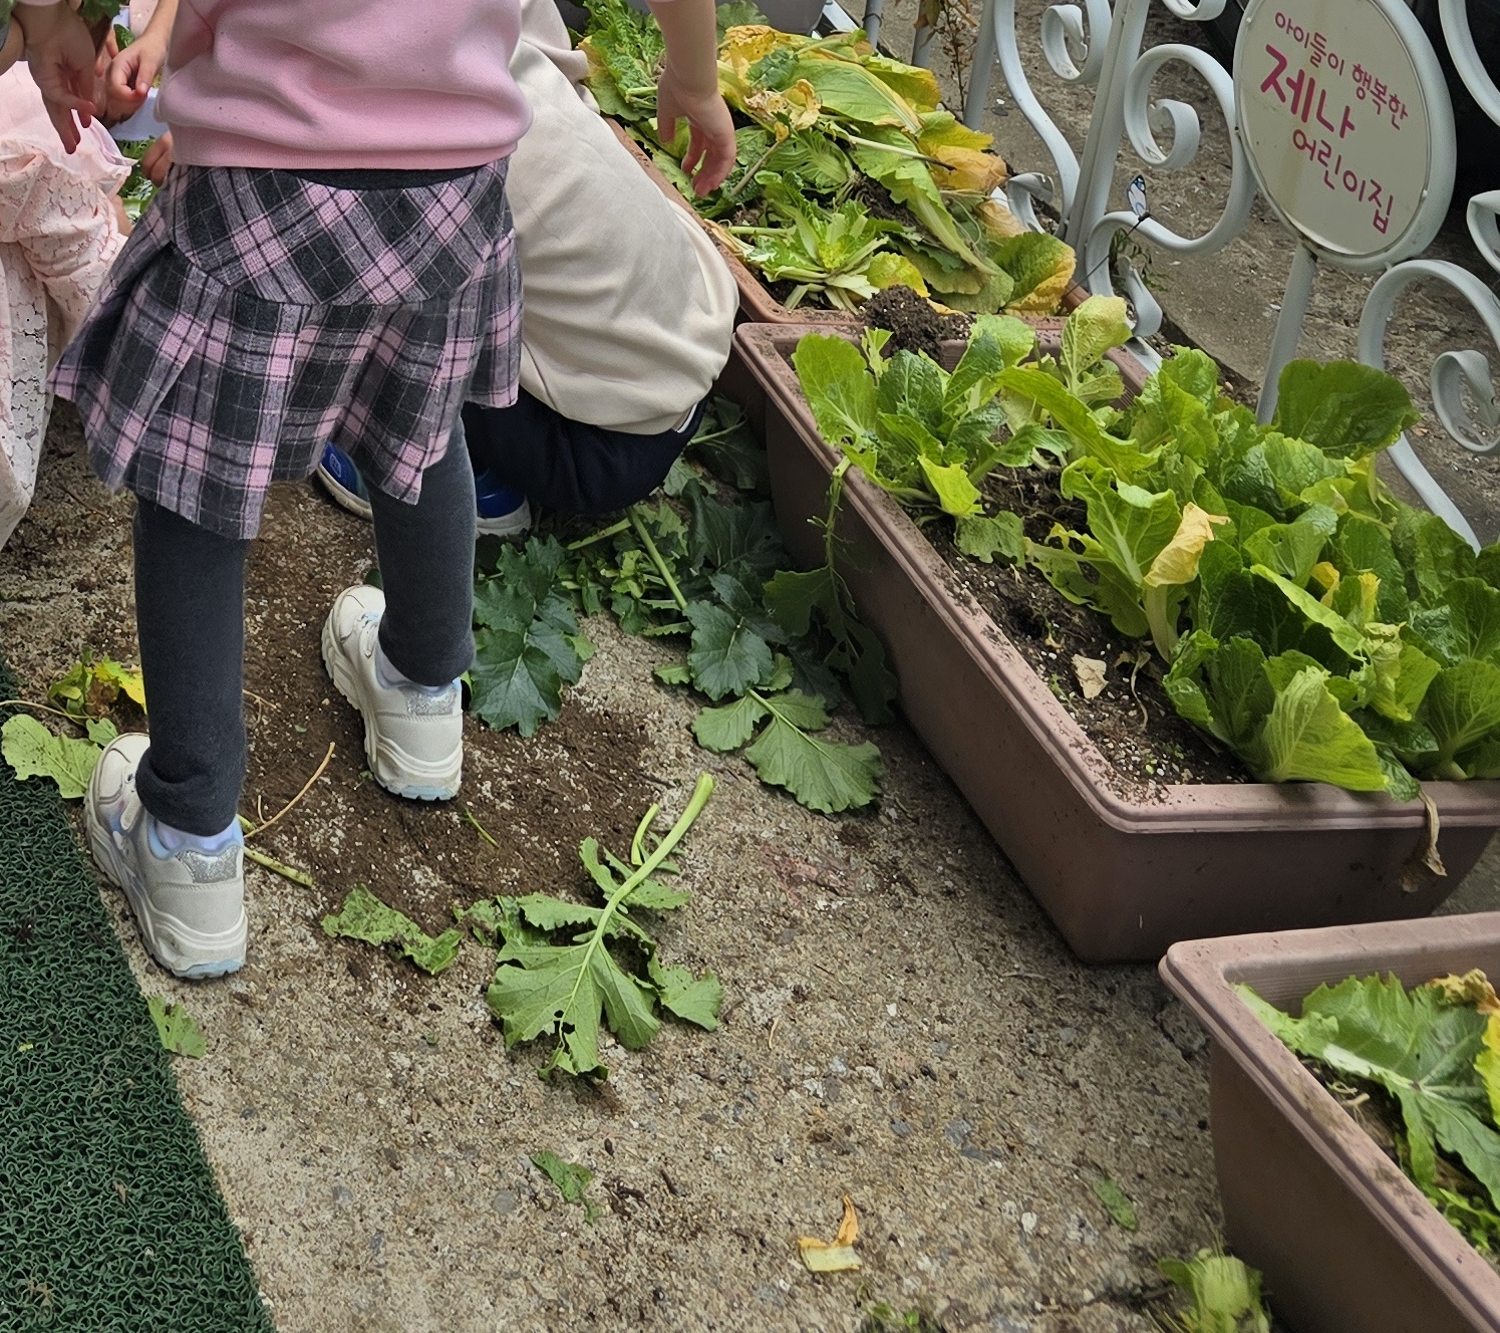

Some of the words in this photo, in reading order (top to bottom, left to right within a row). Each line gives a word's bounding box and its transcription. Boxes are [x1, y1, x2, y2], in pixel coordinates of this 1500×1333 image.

[1260, 44, 1356, 139] 제나
[1274, 11, 1345, 76] 아이들이
[1352, 62, 1409, 131] 행복한
[1292, 129, 1394, 234] 어린이집
